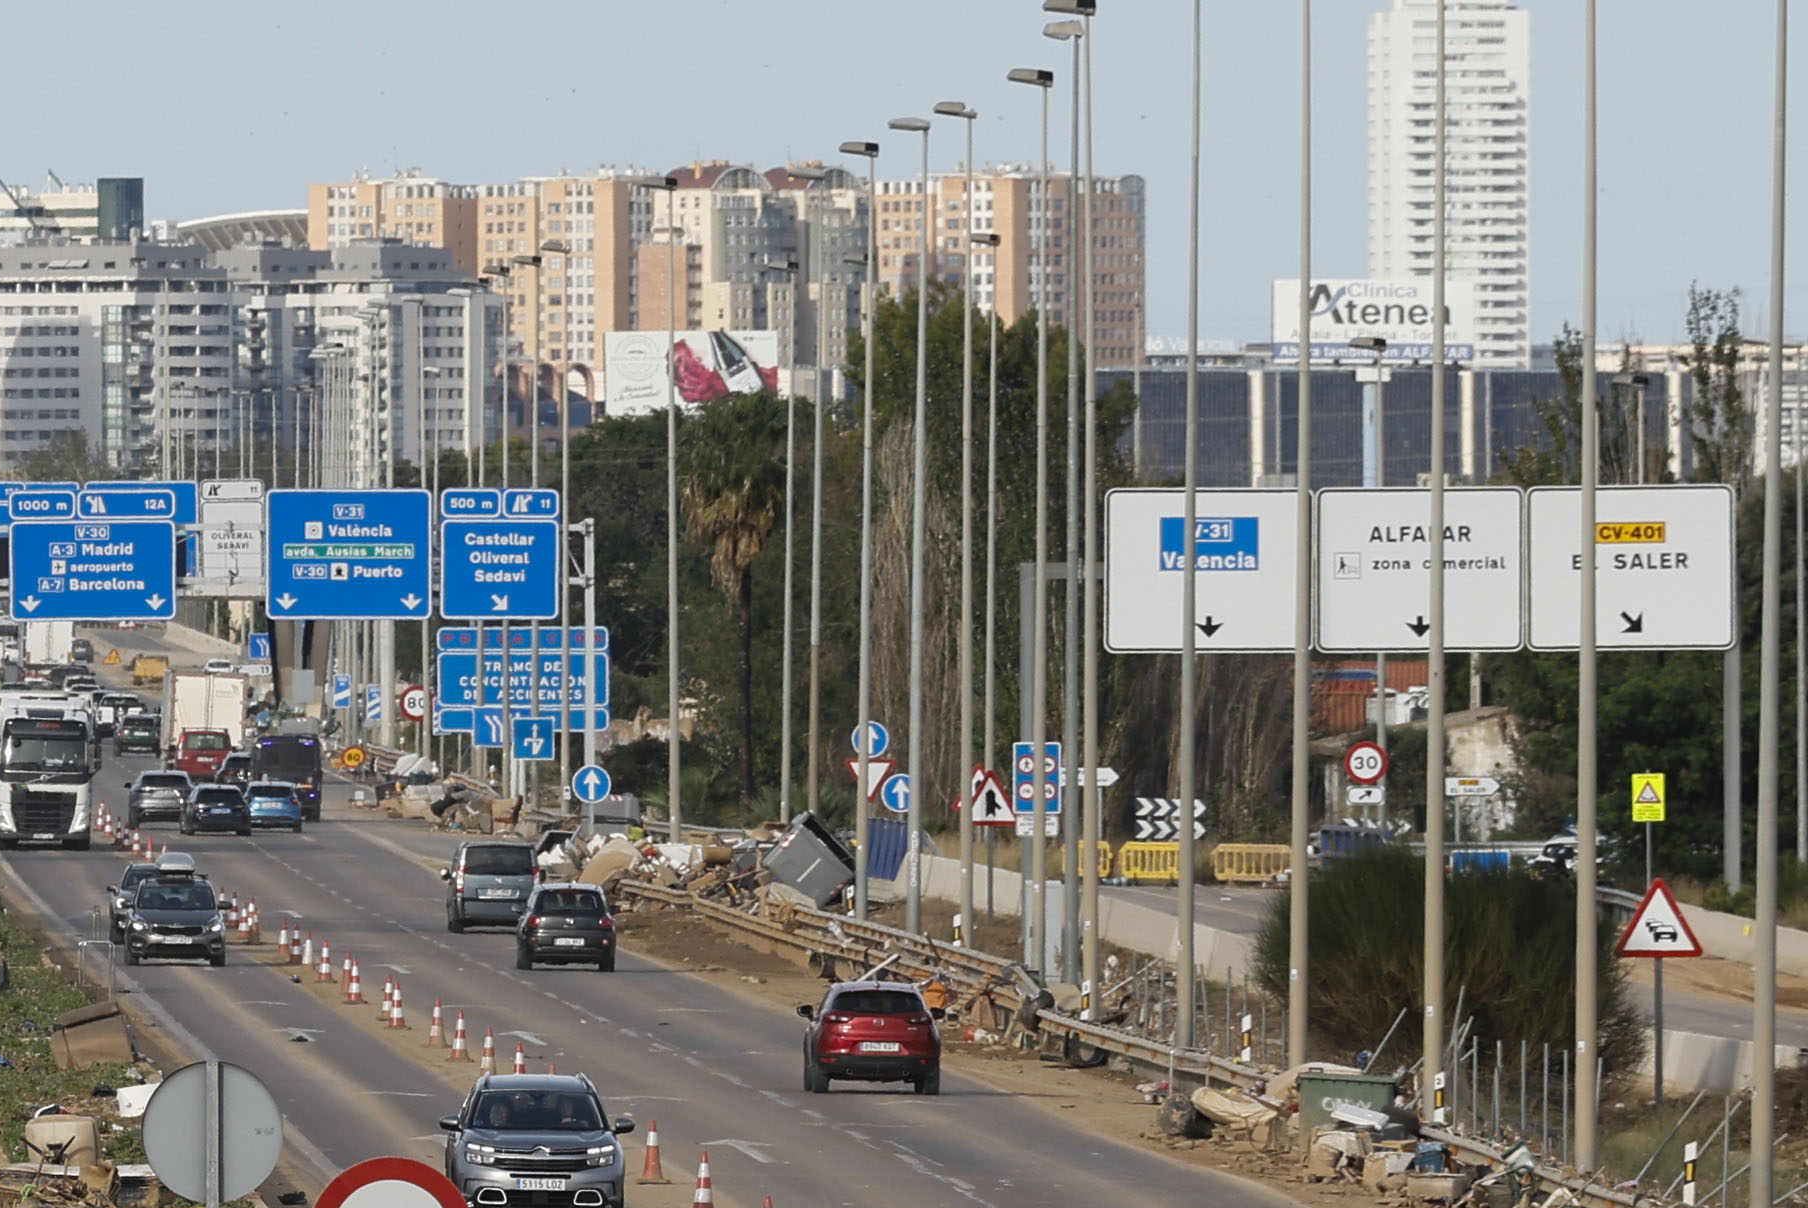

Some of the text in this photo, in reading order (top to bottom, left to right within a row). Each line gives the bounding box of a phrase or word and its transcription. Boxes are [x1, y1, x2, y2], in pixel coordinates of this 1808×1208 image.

[17, 500, 68, 511] 1000 m
[144, 499, 167, 511] 12A
[450, 497, 493, 509] 500 m
[540, 498, 552, 509] 11
[327, 523, 393, 538] València
[1369, 526, 1473, 543] ALFAAR
[1598, 525, 1664, 540] CV-401
[464, 532, 535, 546] Castellar
[81, 542, 134, 556] Madrid
[285, 545, 318, 558] avda.
[373, 544, 412, 557] March
[468, 551, 530, 564] Oliveral
[1163, 551, 1256, 570] Vaencia
[1372, 555, 1506, 570] zona cmercial
[1613, 552, 1689, 570] SALER
[70, 561, 134, 576] aeropuerto
[353, 565, 403, 578] Puerto
[69, 577, 145, 591] Barcelona
[346, 752, 361, 762] 80
[1353, 755, 1379, 771] 30
[521, 1179, 544, 1189] 5115
